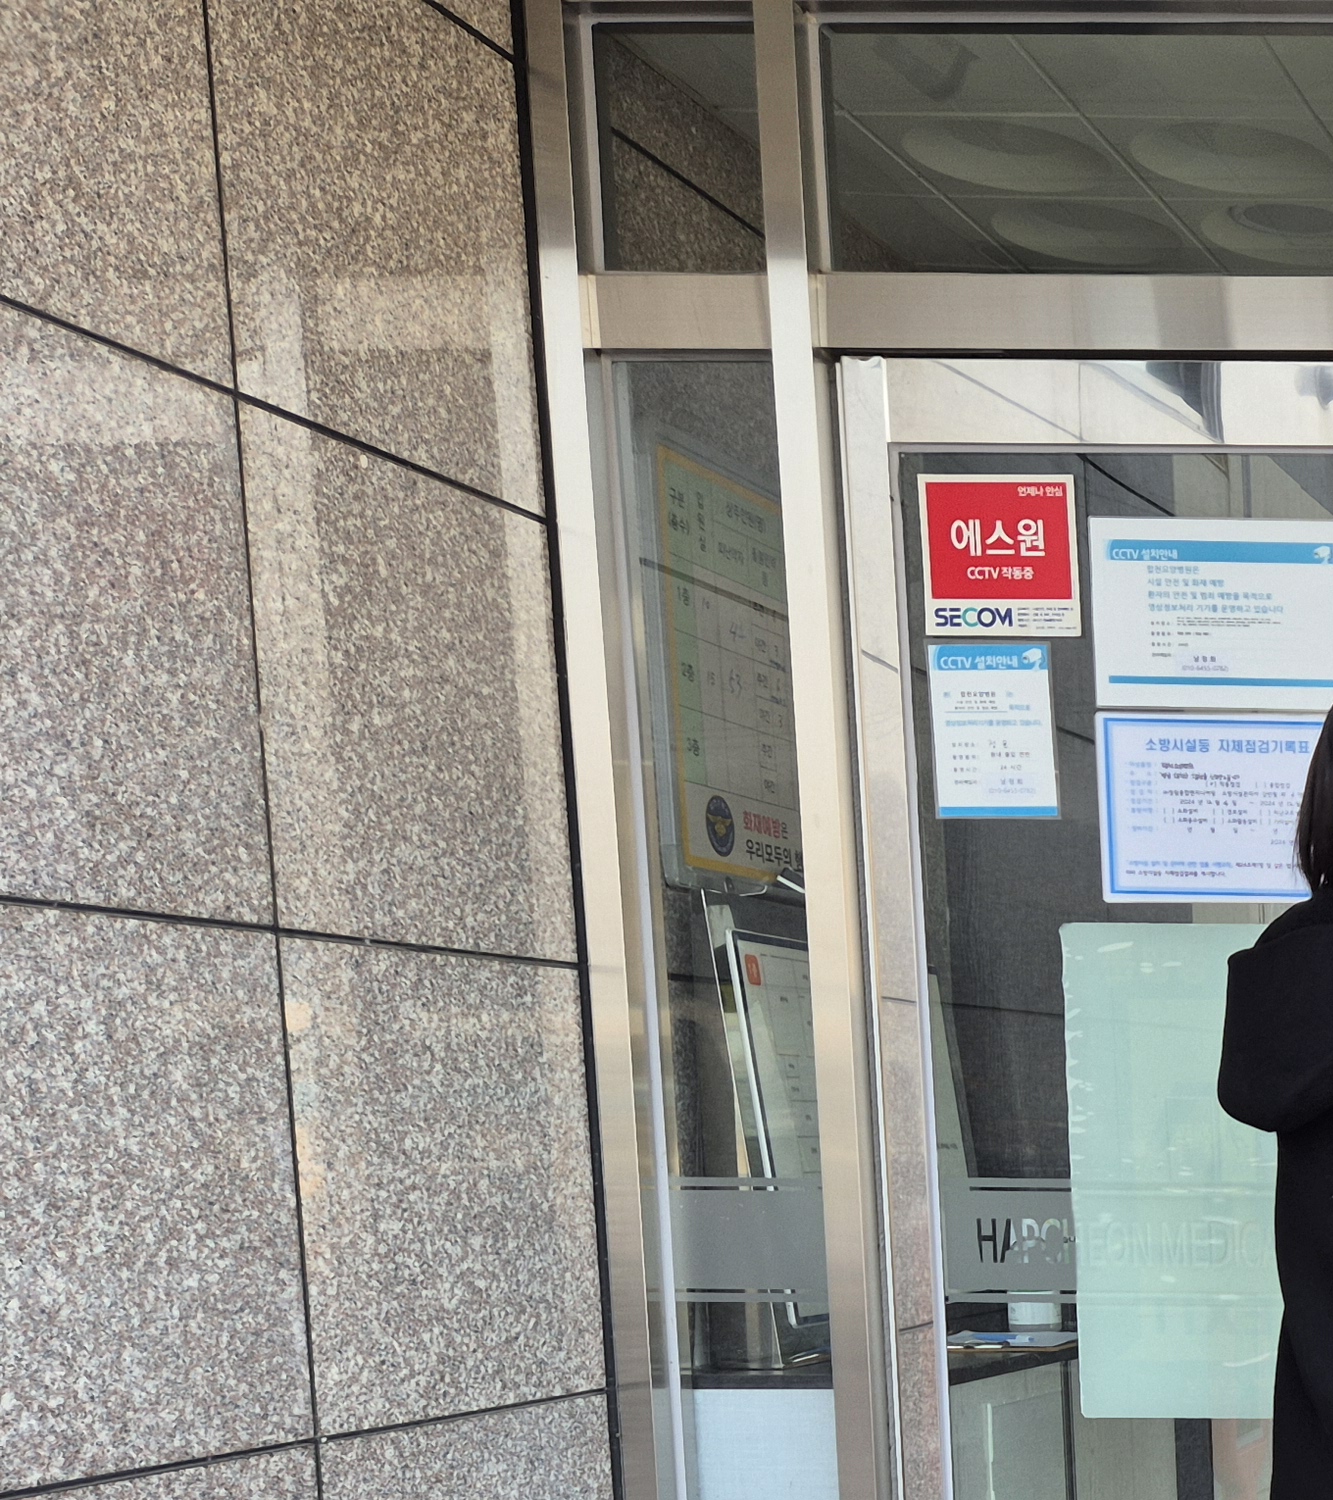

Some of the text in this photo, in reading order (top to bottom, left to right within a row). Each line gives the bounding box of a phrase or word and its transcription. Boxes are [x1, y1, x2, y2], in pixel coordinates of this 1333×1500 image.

[1017, 486, 1063, 497] 언제나 안심
[951, 518, 1045, 556] 에스원
[1112, 549, 1178, 560] CCTV 설치안내
[967, 567, 1034, 580] CCTV 작동중
[934, 607, 1013, 627] SECOM
[940, 655, 1018, 669] CCTV 설치안내
[1145, 738, 1310, 753] 소방시설등 자체점검기록표
